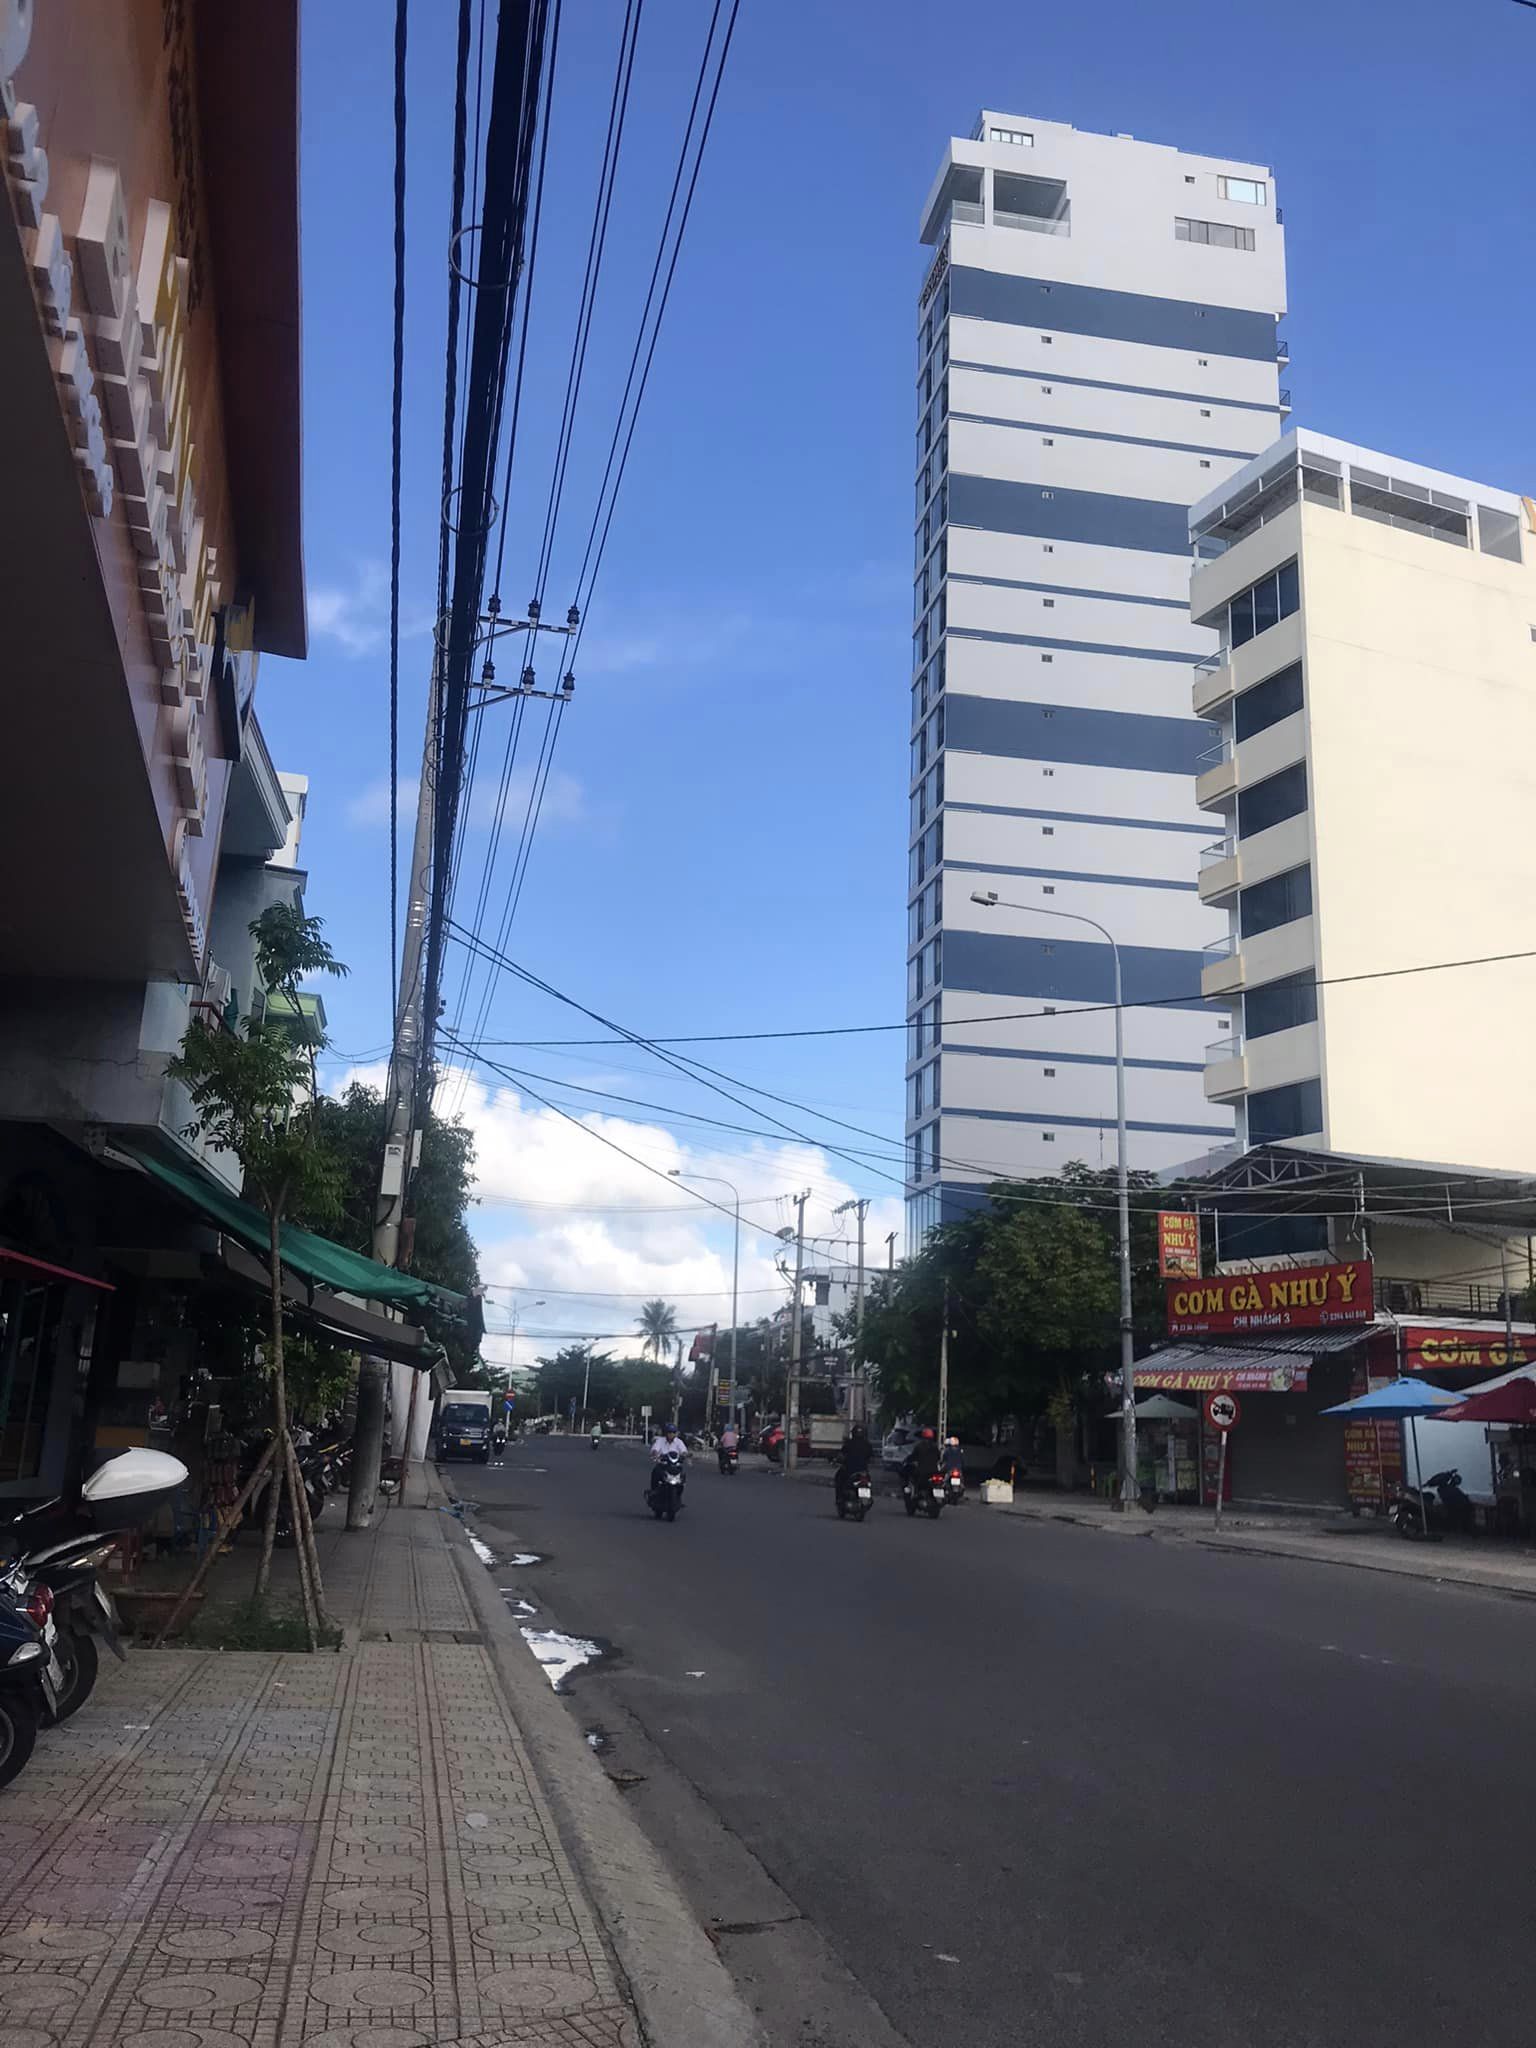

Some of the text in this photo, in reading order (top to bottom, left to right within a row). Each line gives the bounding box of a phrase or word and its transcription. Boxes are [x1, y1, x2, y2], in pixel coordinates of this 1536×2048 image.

[1174, 1288, 1224, 1315] CƠM
[1230, 1277, 1264, 1311] GÀ
[1269, 1271, 1330, 1309] NHƯ
[1336, 1265, 1357, 1303] Ý
[1233, 1312, 1291, 1327] CHI NHÁNH 3
[1421, 1336, 1481, 1365] CƠM
